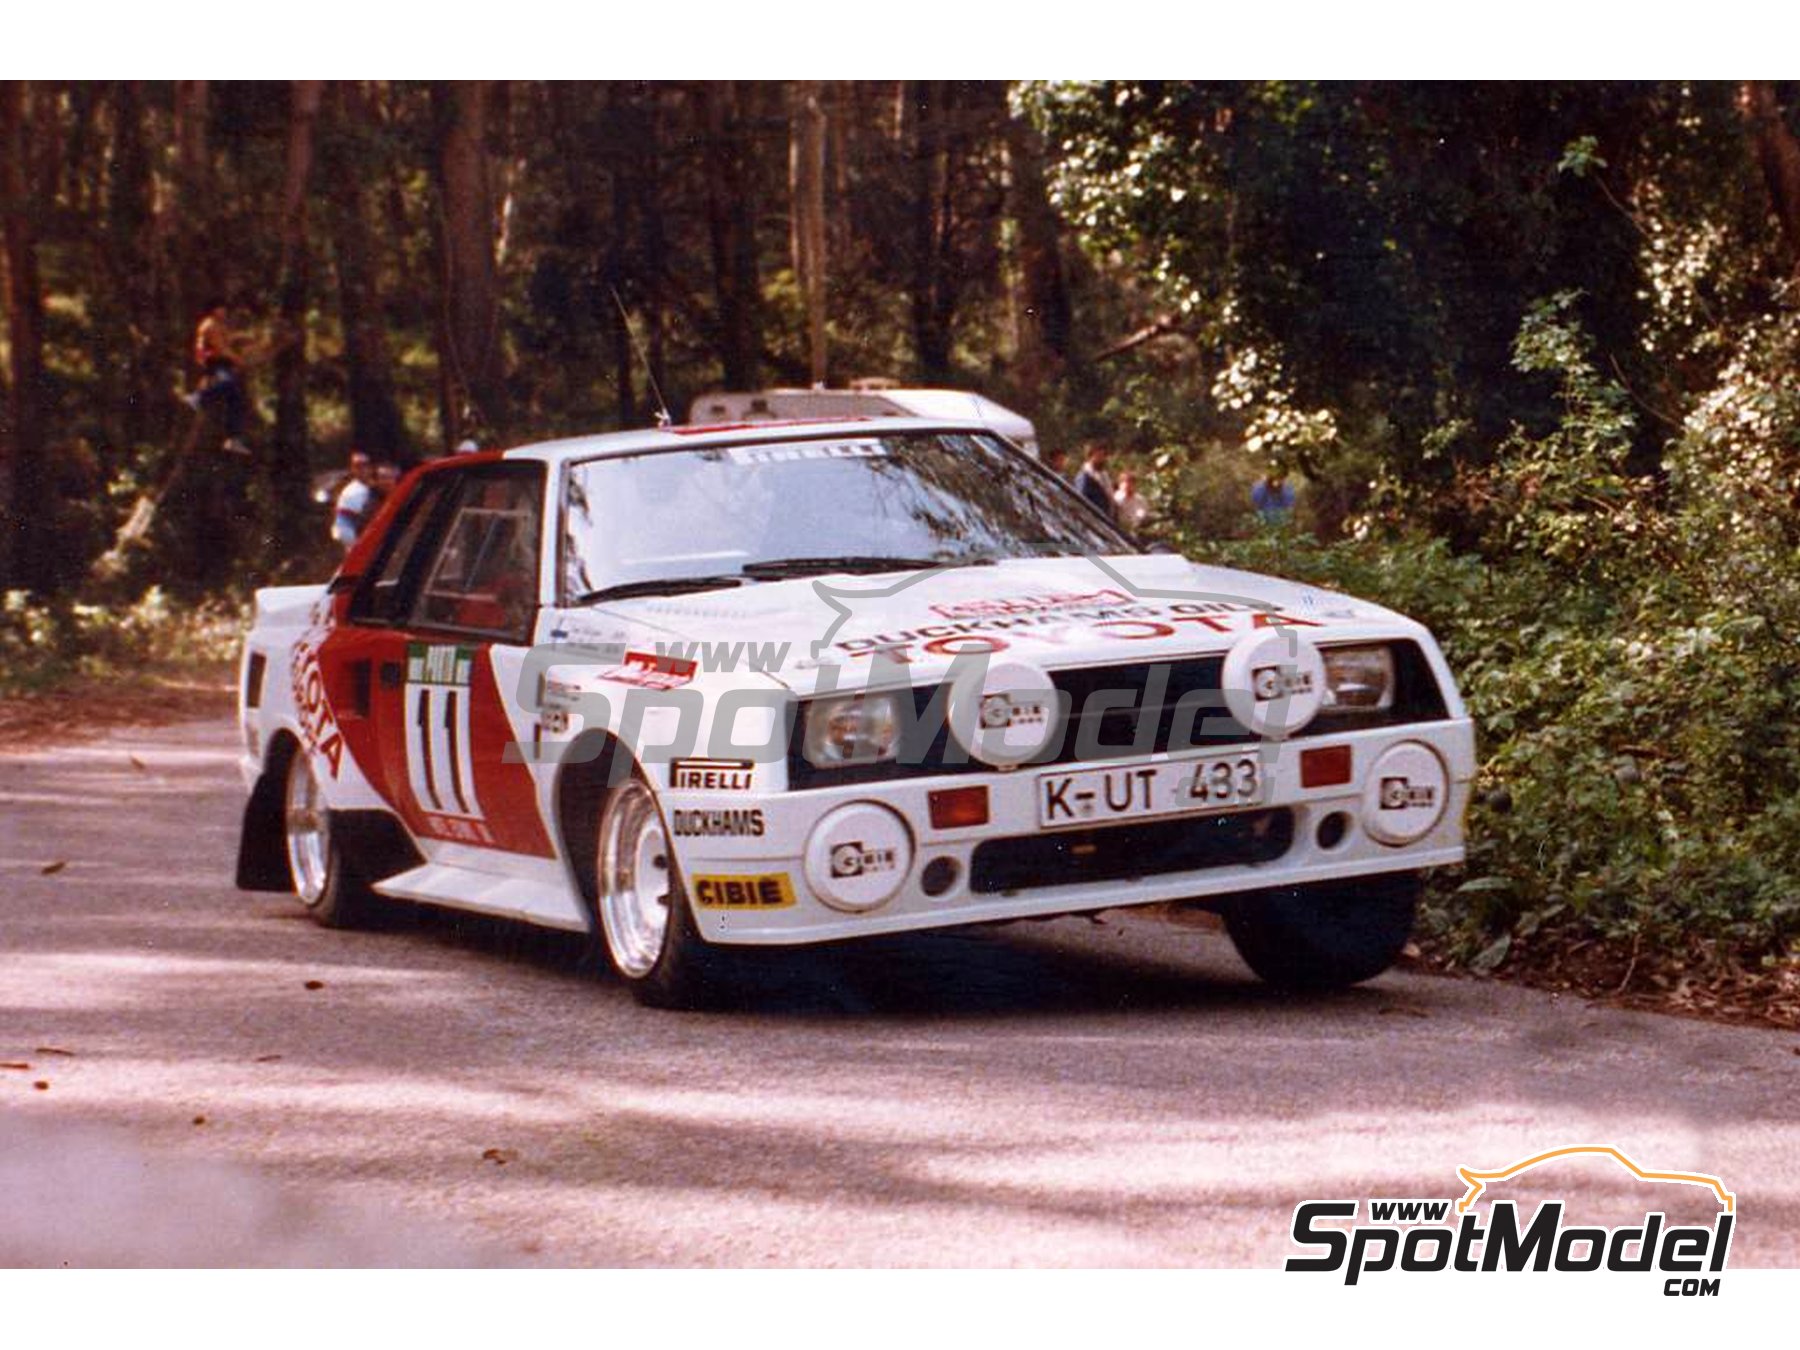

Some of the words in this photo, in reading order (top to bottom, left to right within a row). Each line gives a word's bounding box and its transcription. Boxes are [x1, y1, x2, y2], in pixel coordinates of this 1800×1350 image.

[418, 689, 470, 814] 11
[670, 758, 755, 789] PIRELLI
[674, 809, 765, 836] DUCKHAMS
